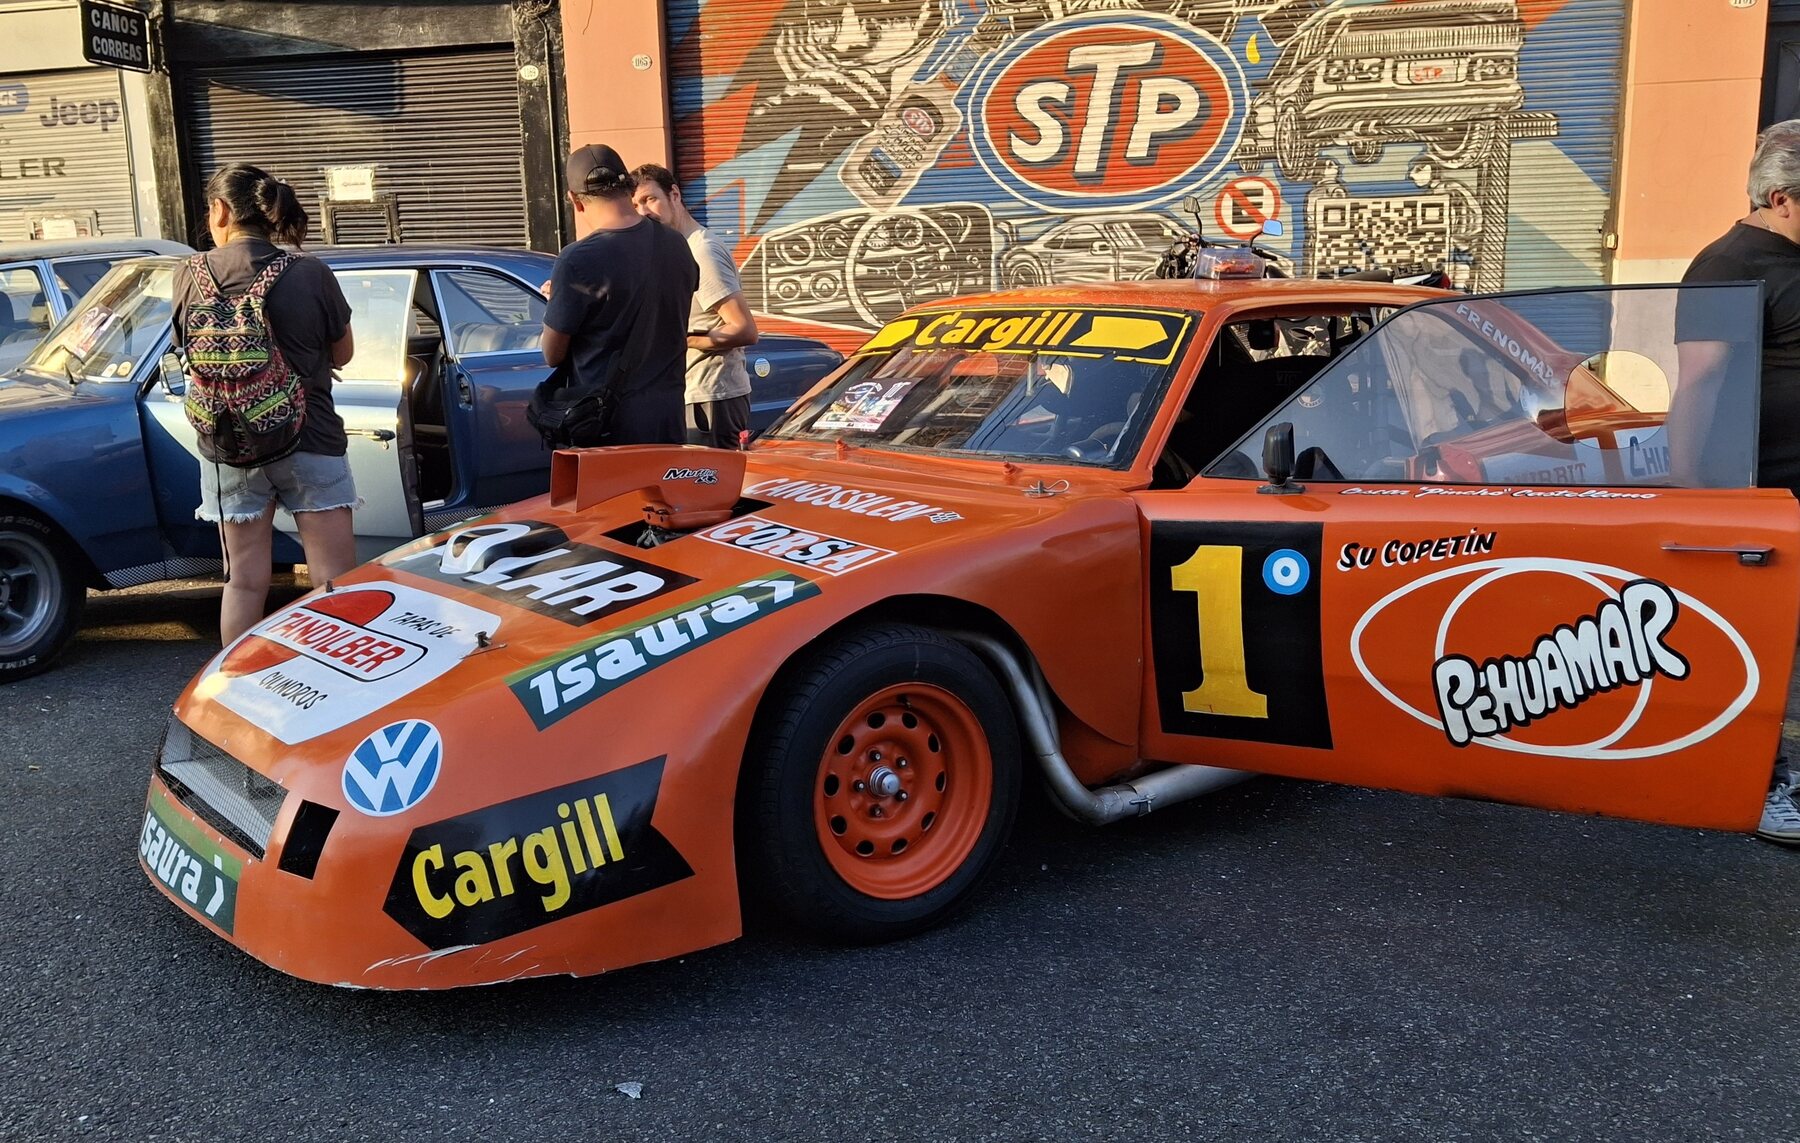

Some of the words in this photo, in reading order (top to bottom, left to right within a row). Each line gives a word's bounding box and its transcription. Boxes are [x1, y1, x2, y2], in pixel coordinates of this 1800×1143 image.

[91, 8, 138, 36] CAÑOS
[92, 35, 142, 62] CORREAS
[40, 96, 119, 131] Jeep
[1010, 41, 1201, 173] STP
[915, 311, 1083, 351] Cargill
[710, 520, 879, 572] CORSA
[389, 612, 435, 631] TAPAS
[265, 612, 406, 673] TANDILBER
[259, 671, 328, 710] CILINDROS
[412, 793, 625, 920] Cargill
